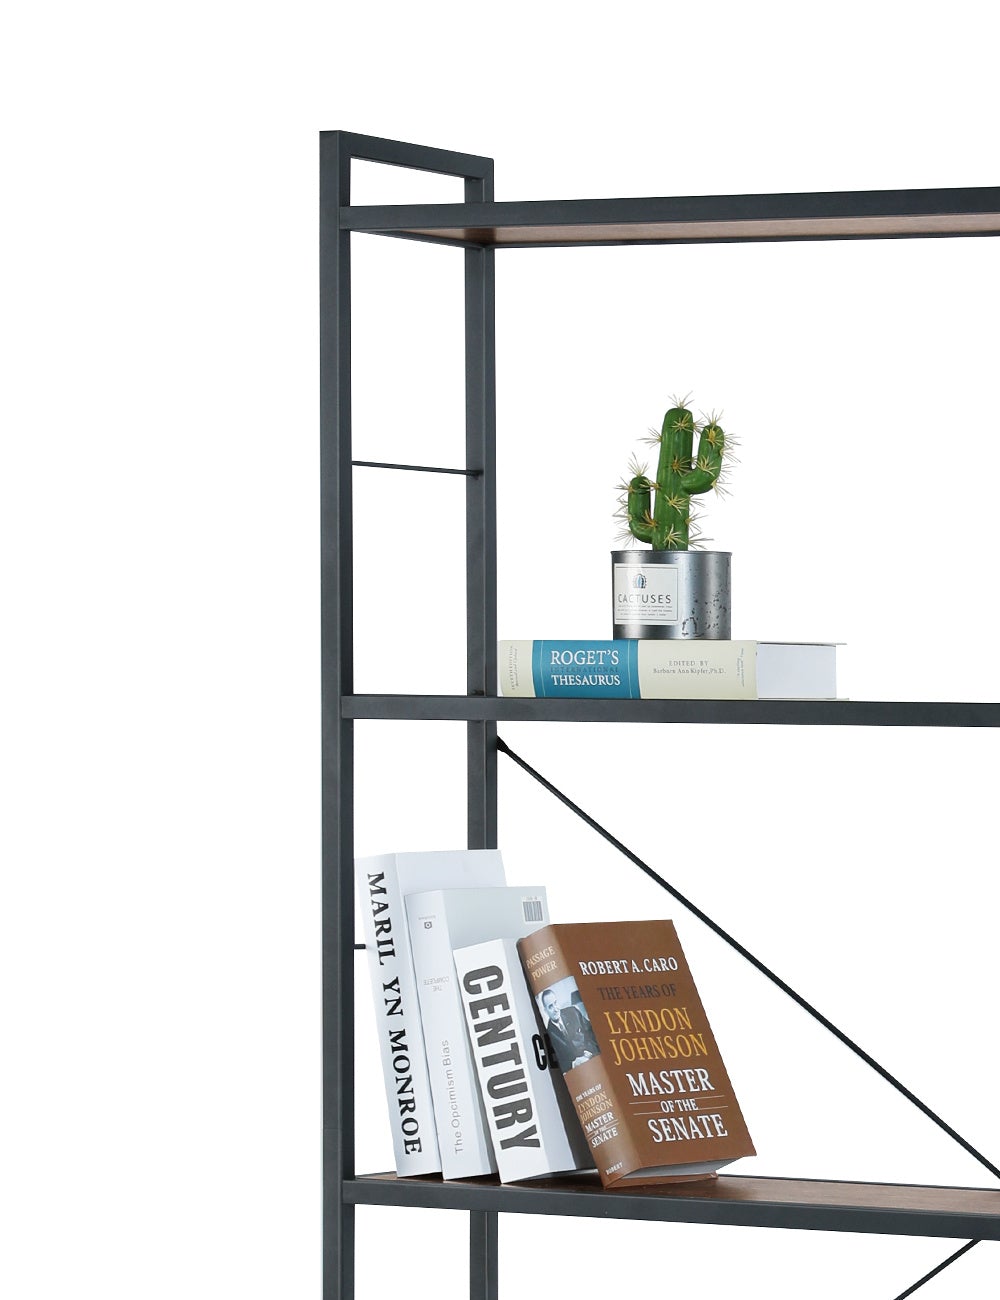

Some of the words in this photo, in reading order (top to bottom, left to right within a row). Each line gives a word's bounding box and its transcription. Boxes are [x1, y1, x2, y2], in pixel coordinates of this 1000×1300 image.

[617, 594, 672, 604] CACTUSES
[550, 649, 619, 665] ROGET'S
[551, 674, 620, 686] THESAURUS
[367, 871, 396, 965] MARIL
[525, 945, 556, 969] PASSAGE
[579, 959, 629, 976] ROBERT
[631, 959, 644, 973] A.
[643, 956, 678, 973] CARO
[531, 960, 558, 980] POWER
[382, 976, 404, 1016] YN
[598, 986, 624, 1000] THE
[624, 985, 660, 999] YEARS
[661, 983, 677, 997] OF
[604, 1007, 693, 1035] LYNDON
[442, 1039, 450, 1066] Bias
[462, 965, 541, 1150] CENTURY
[609, 1033, 708, 1066] JOHNSON
[388, 1028, 424, 1155] MONROE
[582, 1087, 595, 1098] YEARS
[626, 1068, 715, 1097] MASTER
[577, 1090, 608, 1113] LYNDON
[580, 1098, 614, 1125] JOHNSON
[660, 1100, 675, 1114] OF
[674, 1098, 699, 1112] THE
[585, 1111, 615, 1134] MASTER
[647, 1113, 728, 1144] SENATE
[453, 1130, 463, 1154] The
[591, 1126, 619, 1149] SENATE
